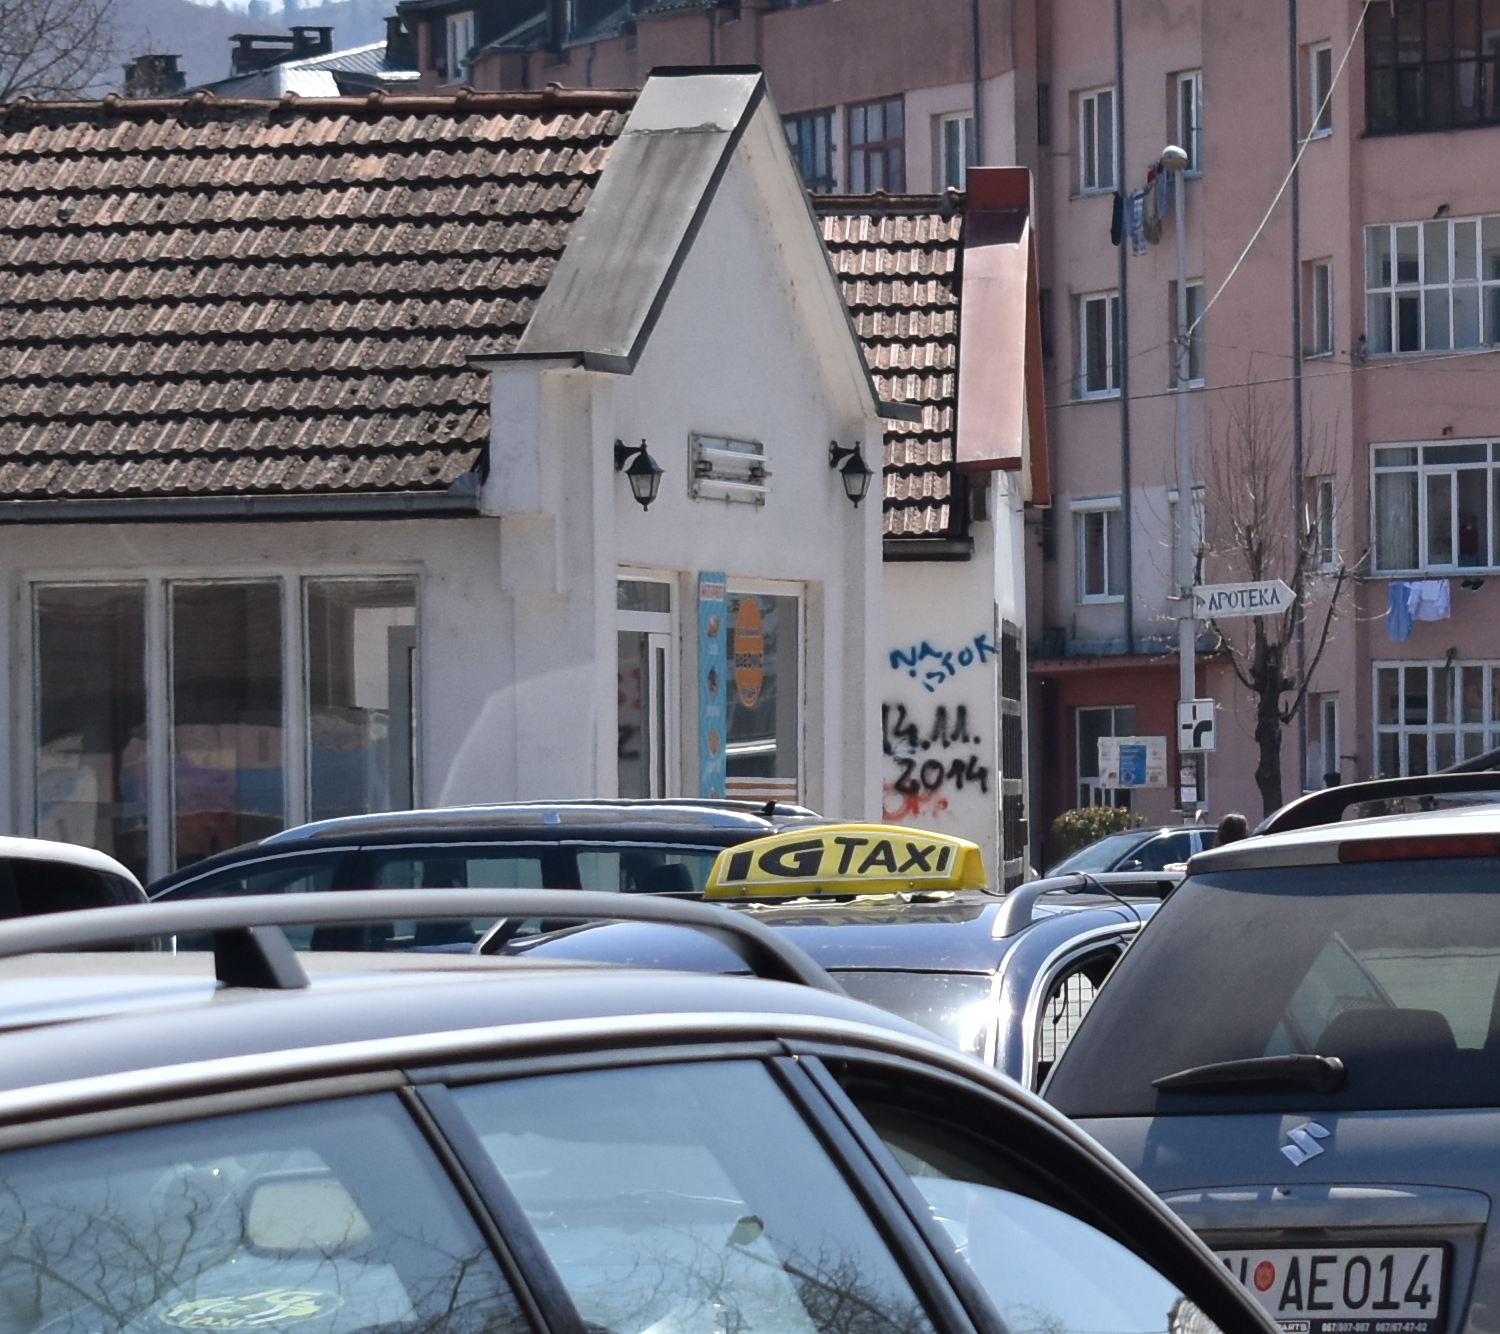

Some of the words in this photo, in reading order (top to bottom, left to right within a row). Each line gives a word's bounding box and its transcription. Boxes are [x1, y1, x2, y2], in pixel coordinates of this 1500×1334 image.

[1209, 587, 1280, 611] APOTEKA
[894, 755, 988, 794] 2014
[727, 838, 825, 878] IG
[834, 836, 951, 874] TAXI
[1278, 1254, 1432, 1310] AE014
